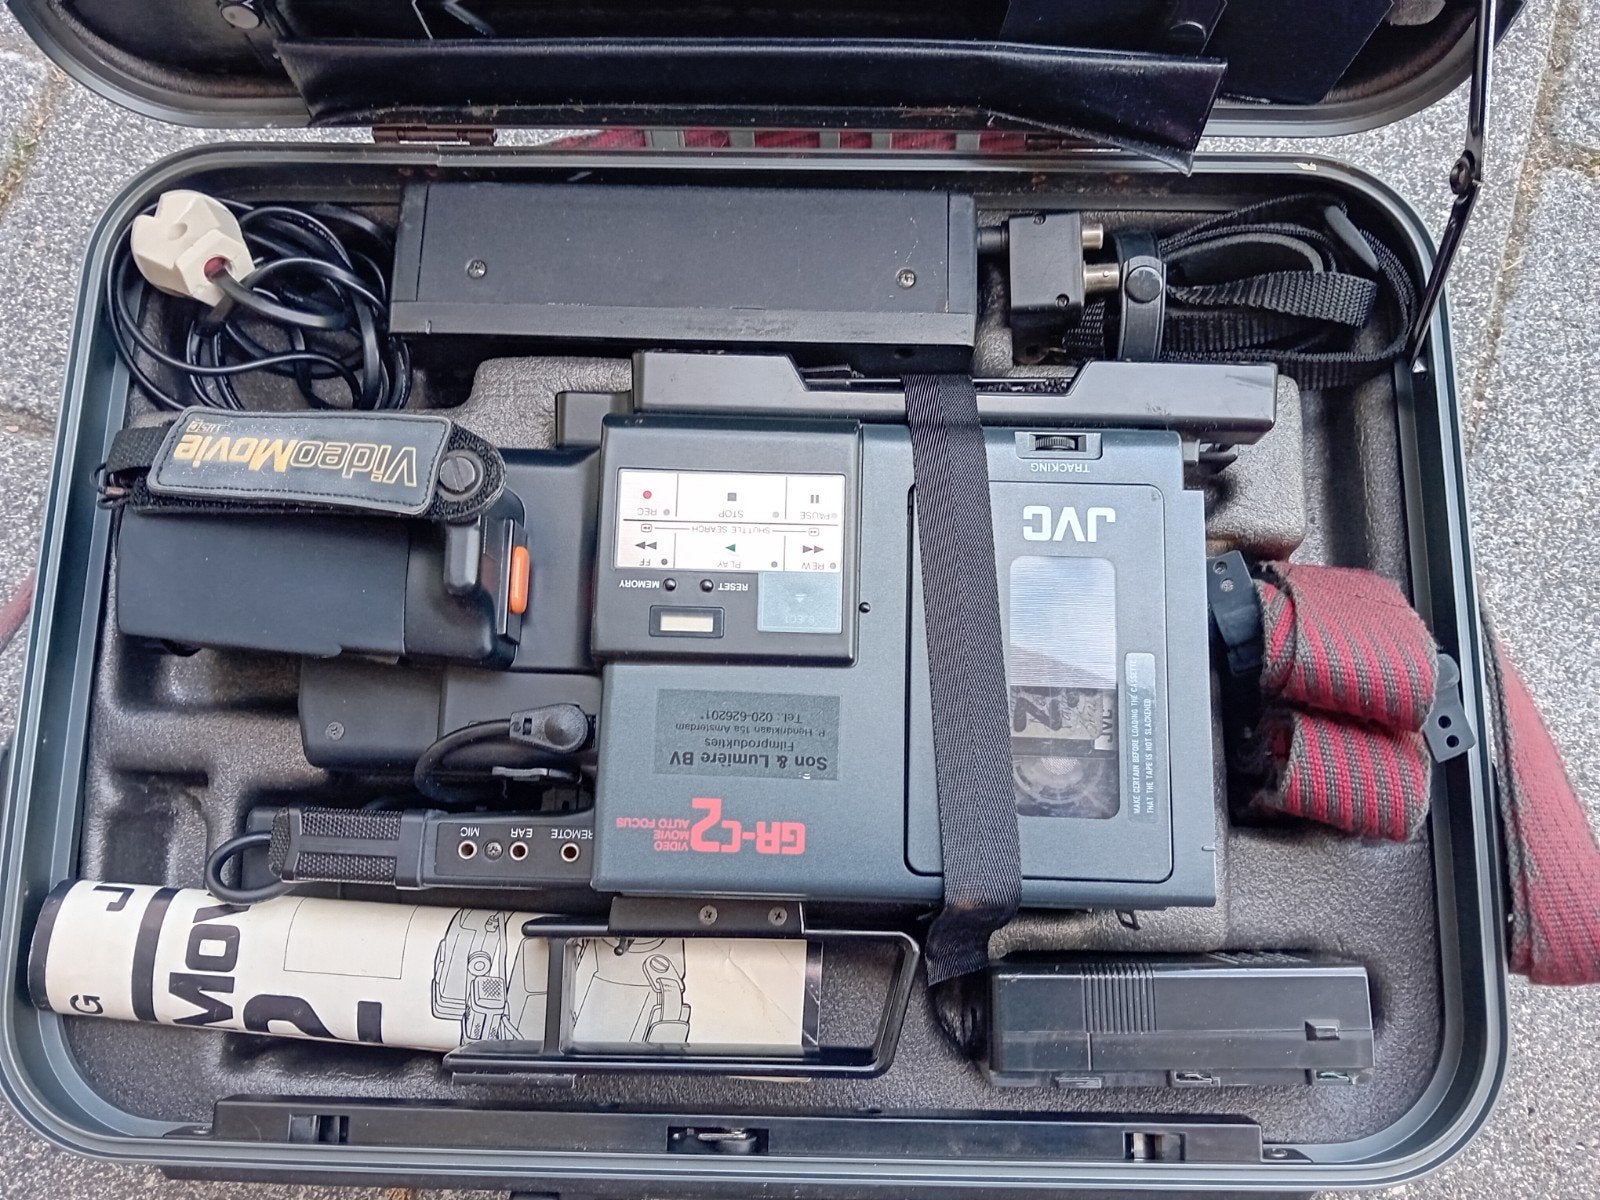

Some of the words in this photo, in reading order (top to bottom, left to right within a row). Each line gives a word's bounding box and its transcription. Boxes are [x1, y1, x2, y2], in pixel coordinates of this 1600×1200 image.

[172, 433, 418, 488] VideoMovie
[1030, 462, 1090, 473] TRACKING
[637, 507, 657, 516] REC
[718, 510, 744, 519] STOP
[800, 511, 830, 520] PAUSE
[691, 525, 728, 534] SEARCH
[1022, 505, 1116, 543] JVC
[731, 527, 770, 535] SHUTTLE
[638, 558, 651, 567] FF
[717, 561, 741, 569] PLAY
[801, 562, 824, 570] REW
[618, 579, 660, 588] MEMORY
[718, 582, 748, 591] RESET
[1144, 698, 1152, 735] SLACKENED
[675, 723, 731, 733] Amsterdam
[733, 724, 750, 734] 15a
[1131, 709, 1139, 738] LOADING
[753, 726, 813, 737] Hendriklaan
[704, 737, 794, 752] Filmprodukties
[1132, 739, 1140, 763] BEFORE
[669, 751, 694, 766] BV
[700, 752, 770, 768] Lumière
[776, 755, 788, 769] &
[1145, 753, 1153, 761] IS
[795, 756, 828, 771] Son
[1145, 762, 1153, 780] TAPE
[1133, 765, 1141, 793] CERTAIN
[1146, 781, 1154, 793] THE
[1133, 795, 1141, 814] MAKE
[1146, 797, 1154, 814] THAT
[616, 817, 656, 828] FOCUS
[658, 818, 690, 829] AUTO
[689, 797, 806, 855] GR-C2
[460, 826, 480, 837] MIC
[510, 827, 533, 838] EAR
[653, 829, 690, 840] MOVIE
[653, 841, 689, 851] VIDEO
